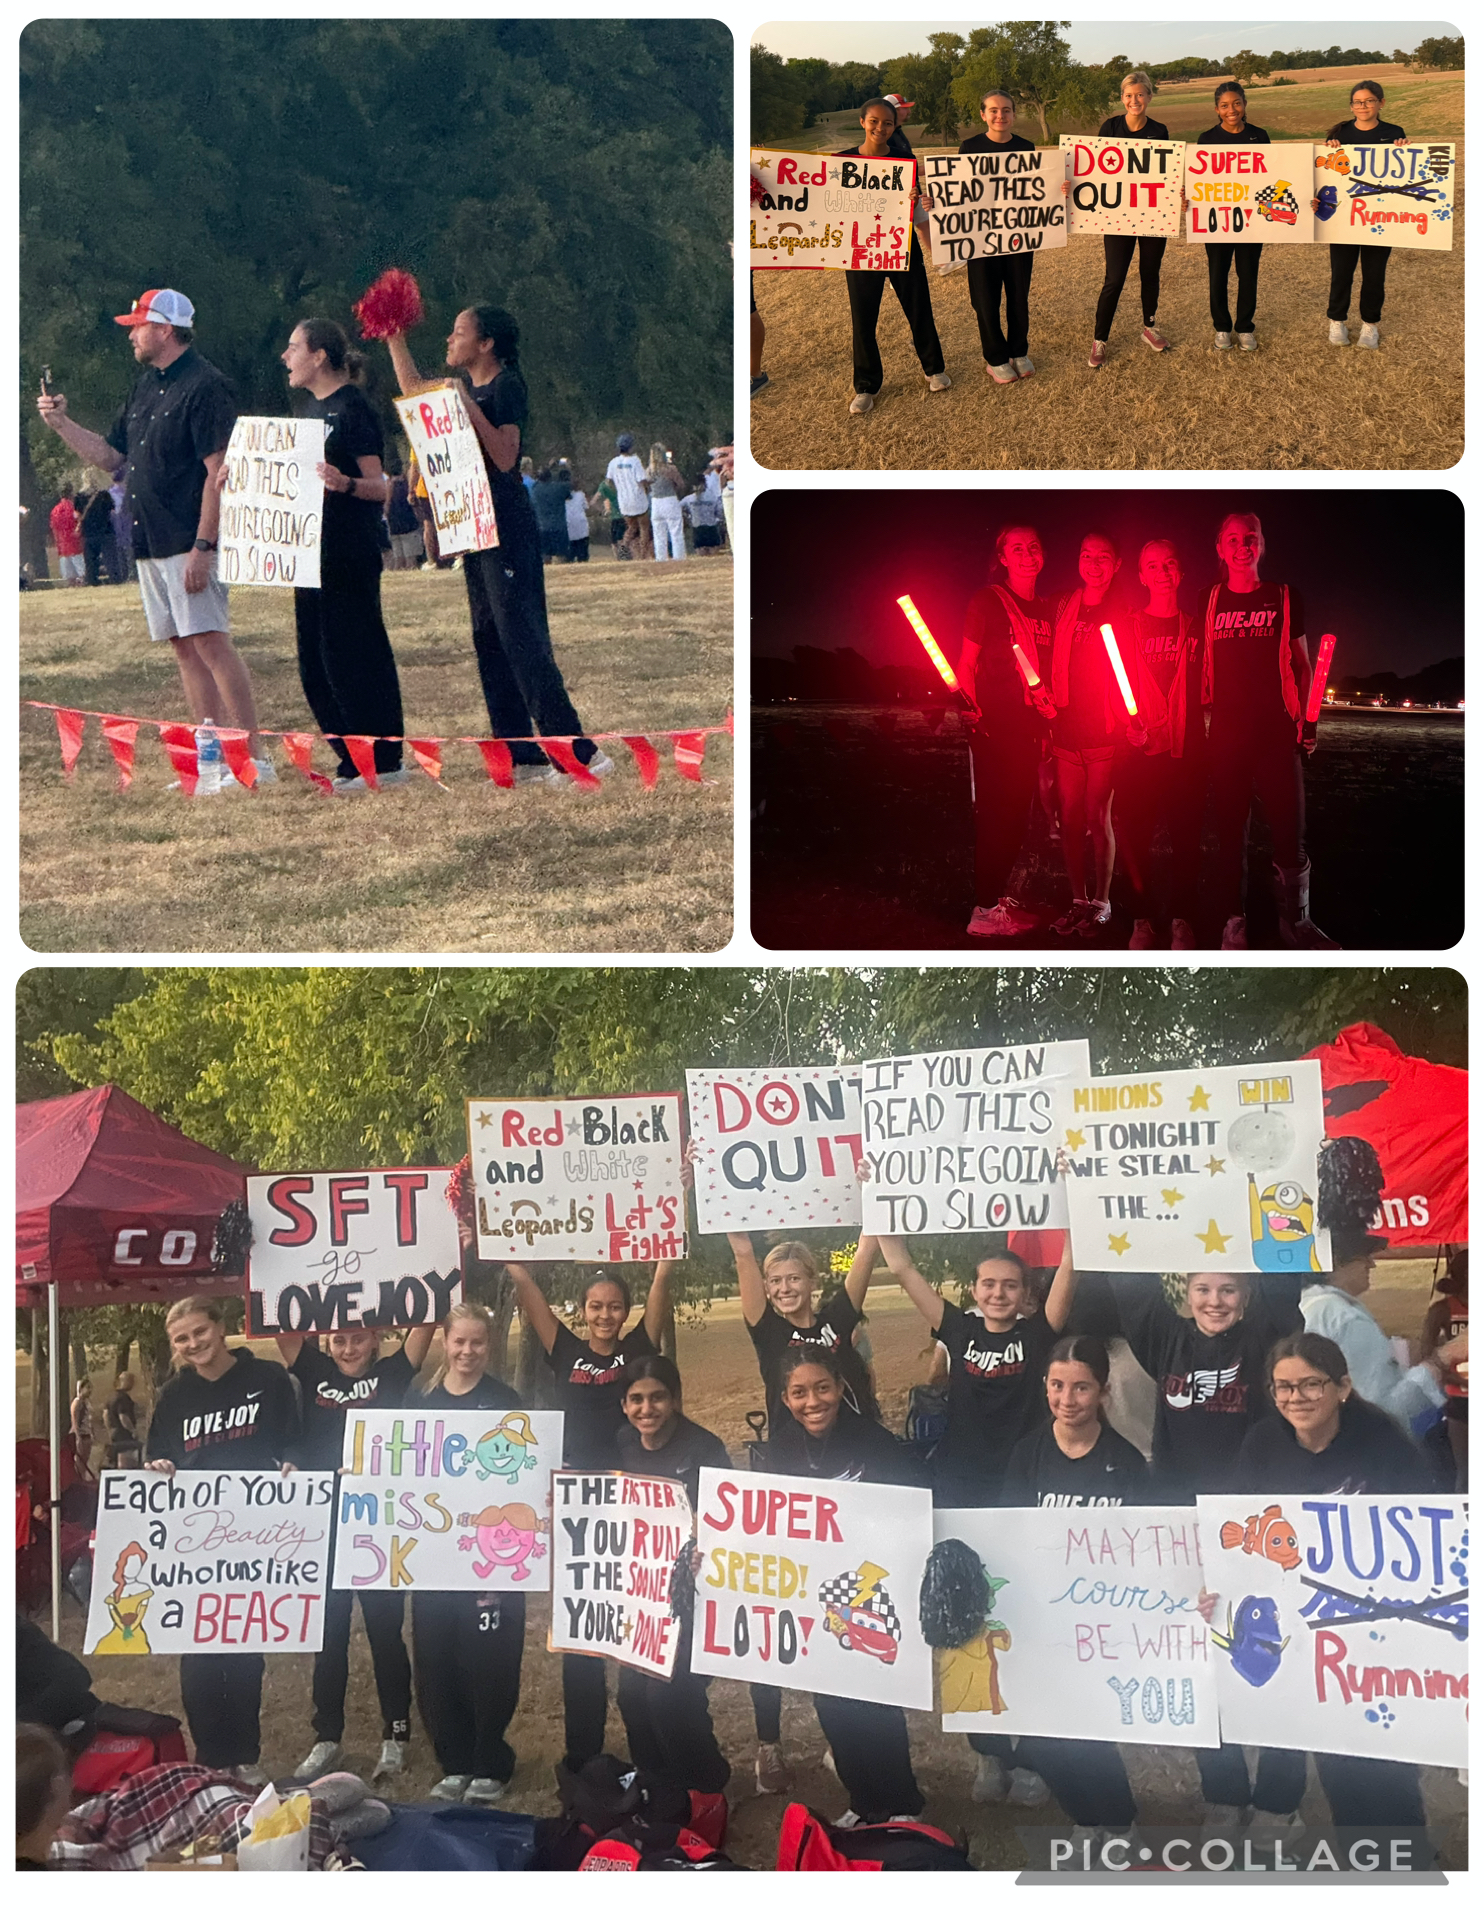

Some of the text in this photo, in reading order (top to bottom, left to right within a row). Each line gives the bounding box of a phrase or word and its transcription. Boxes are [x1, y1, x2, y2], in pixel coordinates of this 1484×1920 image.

[777, 158, 904, 191] Red Black
[926, 152, 1042, 178] IF YOU CAN
[1073, 144, 1173, 177] DON'T
[1188, 150, 1268, 175] SUPER
[1353, 147, 1424, 180] JUST
[759, 187, 887, 213] and White
[928, 176, 1046, 208] READ THIS
[1073, 182, 1165, 213] QUIT
[1191, 182, 1250, 202] SPEED!
[1192, 207, 1253, 233] LOJO!
[1350, 198, 1428, 235] Running
[750, 219, 905, 256] Leopards Let's
[940, 231, 1043, 261] TO SLOW
[851, 248, 909, 271] Fight!
[264, 421, 297, 453] CAN
[419, 398, 453, 439] Red
[427, 438, 452, 478] and
[254, 456, 299, 500] THIS
[223, 545, 296, 582] TO SLOW
[1213, 627, 1275, 640] RACK & FIELD
[1214, 610, 1277, 630] OVEJOY
[865, 1046, 1045, 1093] IF YOU CAN
[1074, 1077, 1291, 1113] MINIONS WIN
[501, 1105, 670, 1147] Red Black
[864, 1091, 1053, 1142] READ THIS
[1085, 1121, 1221, 1151] TONIGHT
[486, 1149, 648, 1184] and White
[978, 1143, 1059, 1184] GOIN
[1069, 1154, 1200, 1178] WE STEAL
[268, 1174, 428, 1247] SFT
[479, 1192, 677, 1246] Leopards Let's
[876, 1188, 1050, 1233] TO SLOW
[609, 1231, 688, 1261] Fight!
[307, 1248, 378, 1285] go
[250, 1267, 461, 1335] LOVEJOY
[352, 1420, 468, 1477] little
[104, 1475, 185, 1514] Each
[305, 1478, 333, 1506] is
[341, 1489, 453, 1533] miss
[556, 1478, 676, 1508] THE FASTER
[703, 1481, 844, 1542] SUPER
[149, 1510, 325, 1562] a Beauty
[562, 1517, 680, 1562] YOU RUN
[1066, 1527, 1140, 1567] MAY
[1302, 1501, 1454, 1585] JUST
[351, 1534, 418, 1587] 5K
[565, 1562, 623, 1592] THE
[705, 1548, 808, 1599] SPEED!
[1049, 1577, 1199, 1613] course
[160, 1590, 321, 1644] a BEAST
[479, 1612, 500, 1631] 33
[703, 1600, 815, 1665] LOJO!
[632, 1609, 672, 1665] DONE
[1075, 1623, 1208, 1662] BE WITH
[1106, 1676, 1195, 1726] YOU
[393, 1720, 406, 1733] 56
